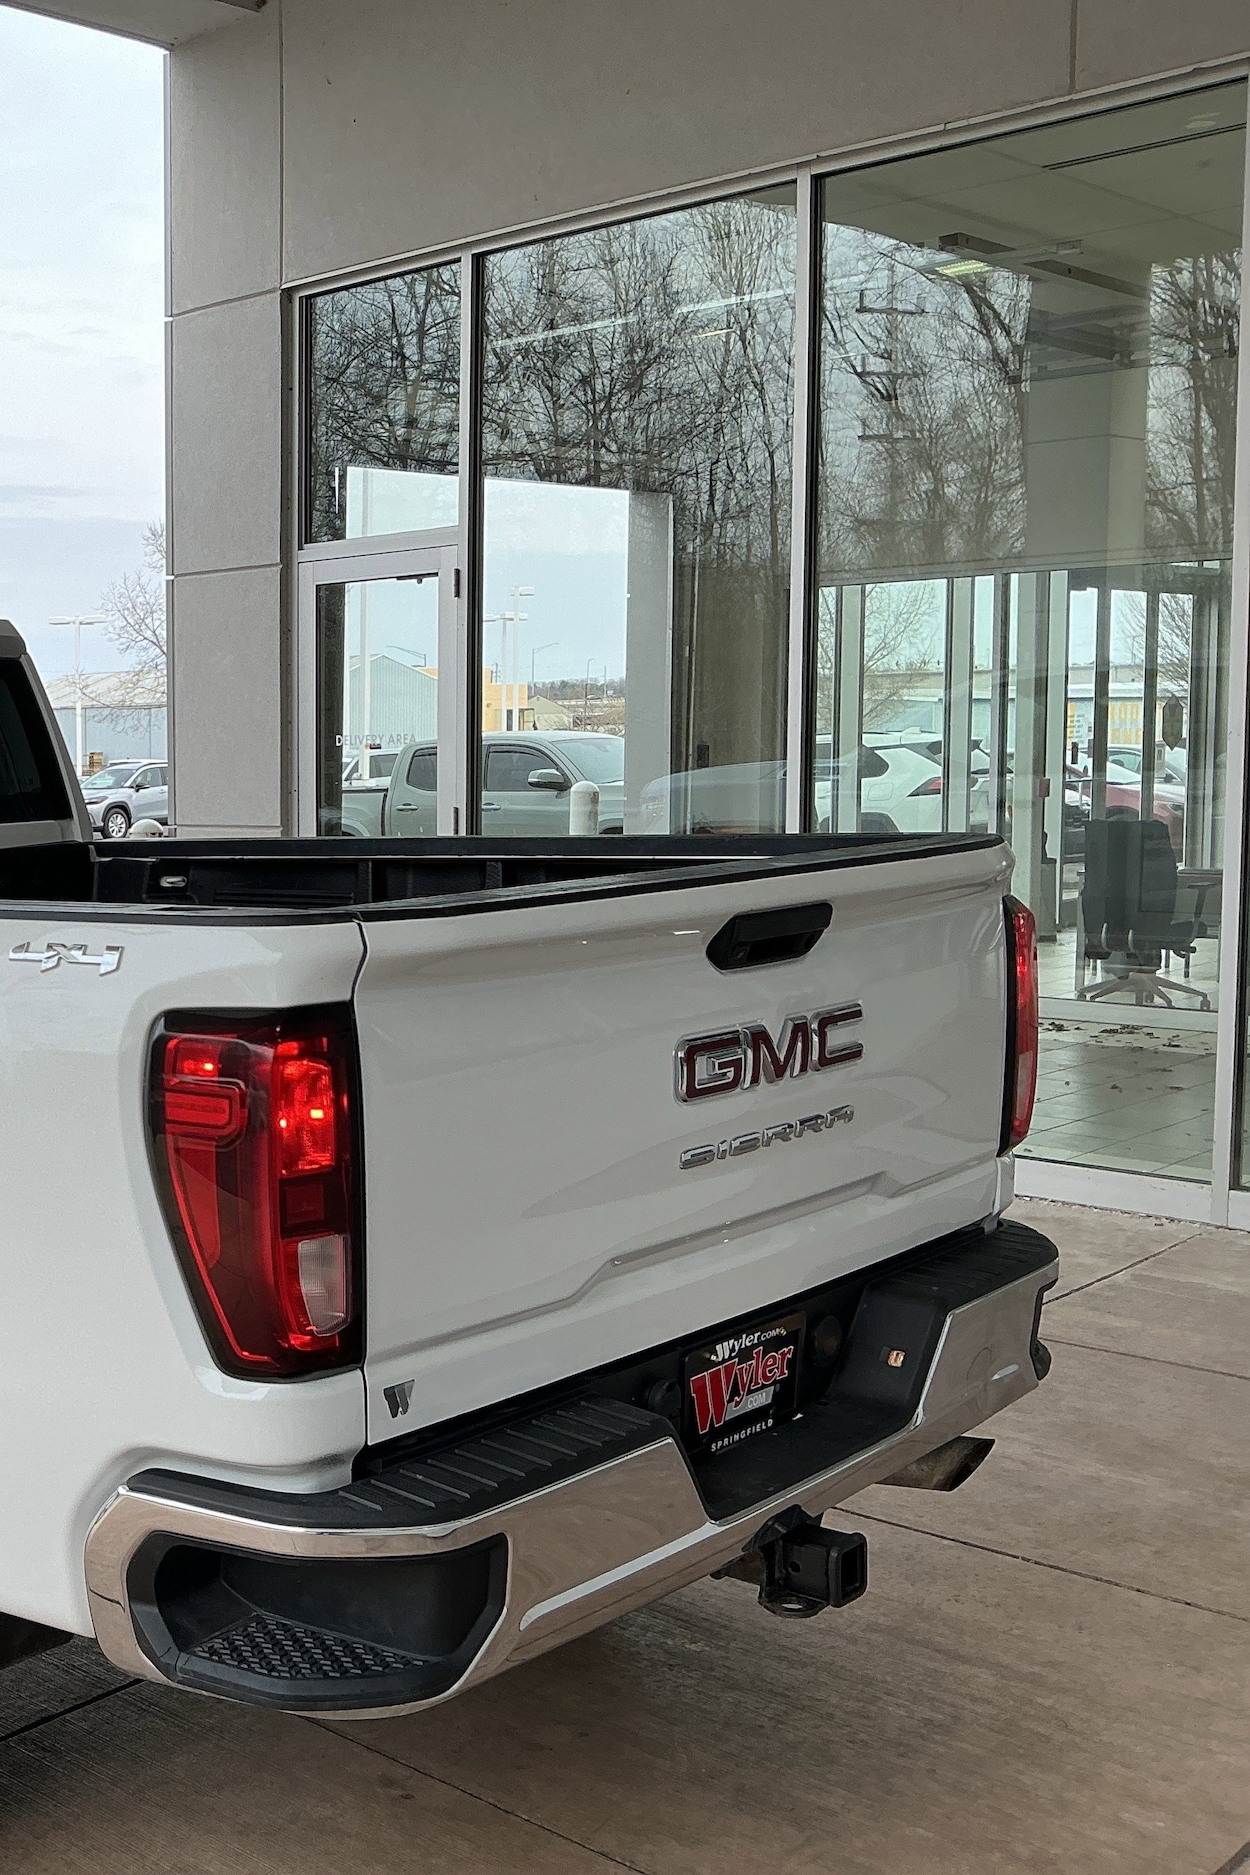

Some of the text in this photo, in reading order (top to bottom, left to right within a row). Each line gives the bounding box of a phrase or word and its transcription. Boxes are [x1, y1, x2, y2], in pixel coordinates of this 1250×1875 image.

[335, 733, 417, 746] DELIVERY AREA
[673, 1001, 864, 1104] GMC
[679, 1104, 855, 1170] SIERRA
[690, 1346, 794, 1434] Wyler
[711, 1418, 774, 1452] SPRINGFIELD
